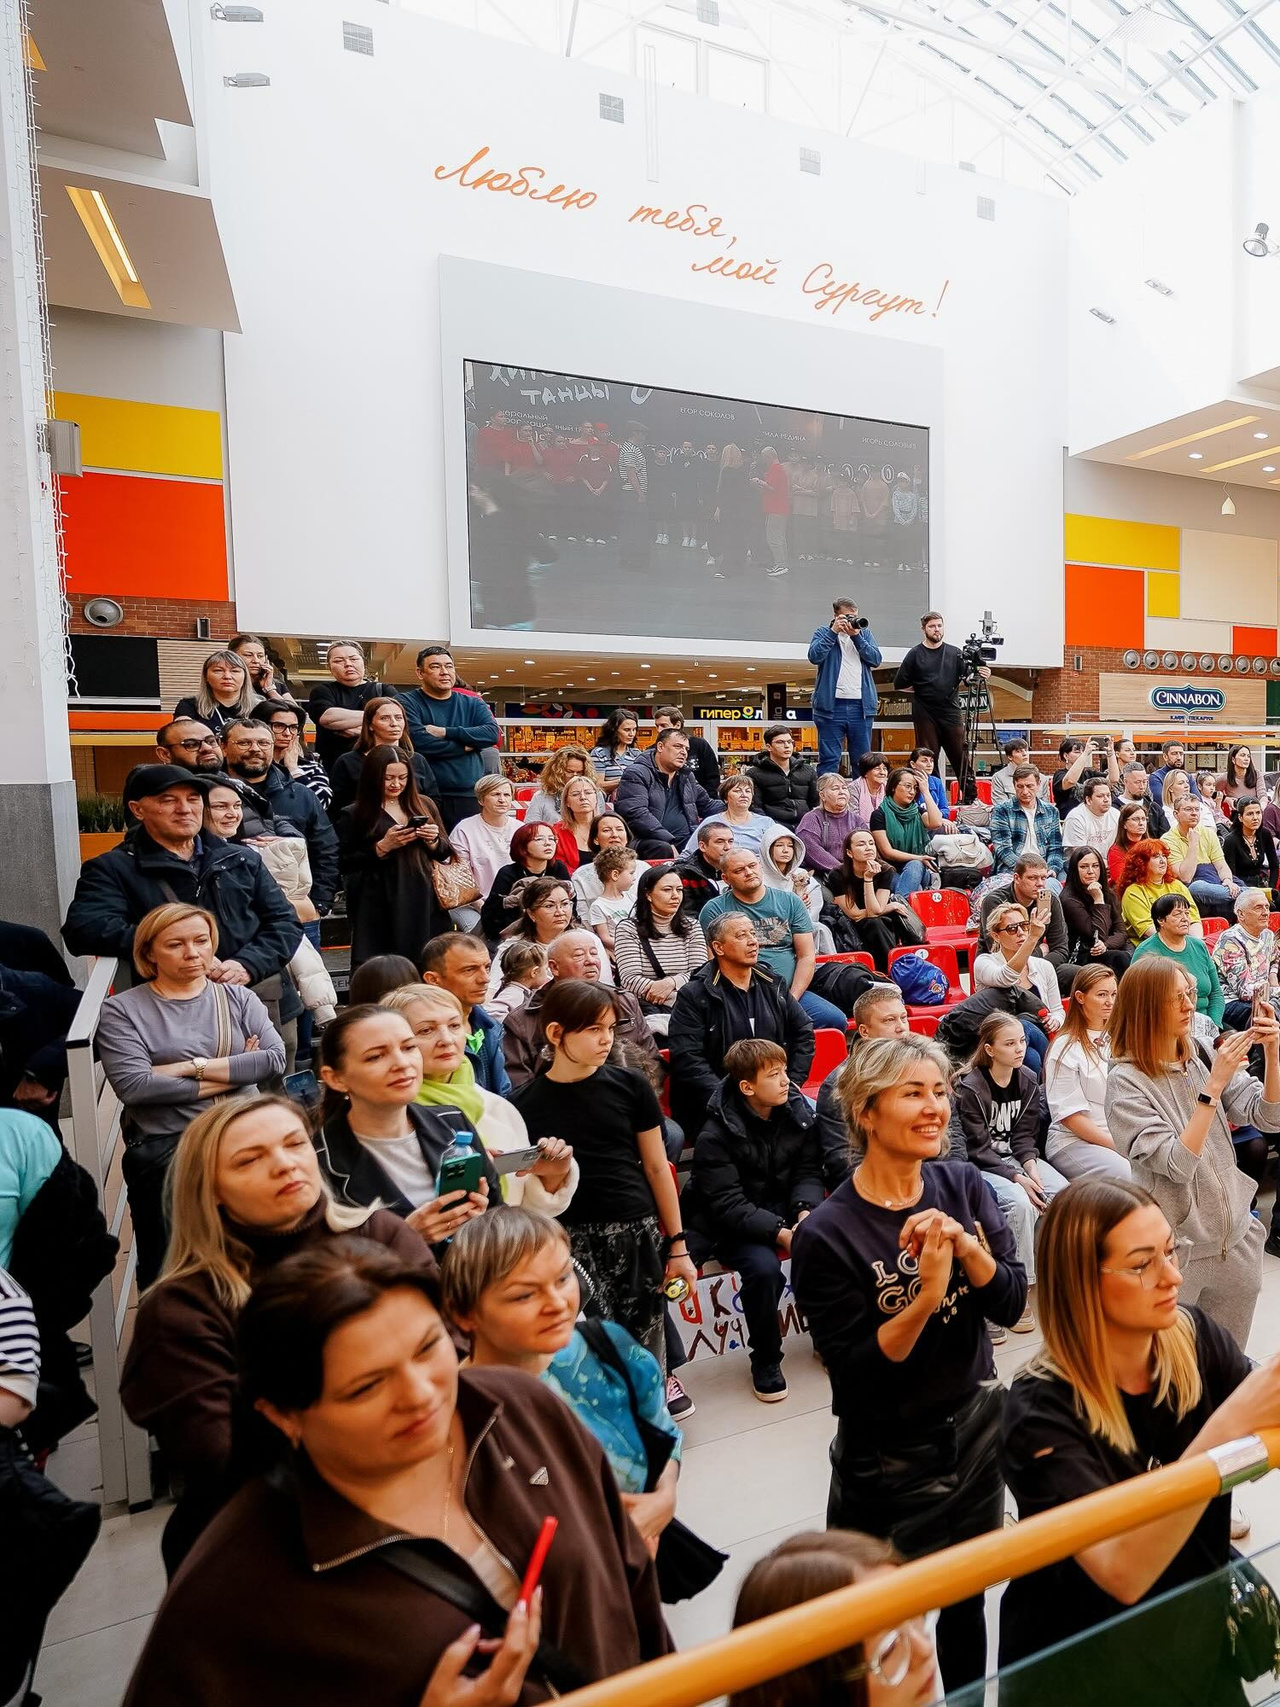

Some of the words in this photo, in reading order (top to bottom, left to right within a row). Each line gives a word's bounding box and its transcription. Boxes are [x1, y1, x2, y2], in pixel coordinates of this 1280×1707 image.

[434, 146, 599, 211] Люблю
[628, 203, 738, 249] тебя,
[691, 254, 782, 285] мой
[802, 263, 950, 321] Сургут!
[520, 381, 610, 406] ТАНЦЫ
[1156, 690, 1221, 706] CINNABON
[700, 709, 741, 721] гипер
